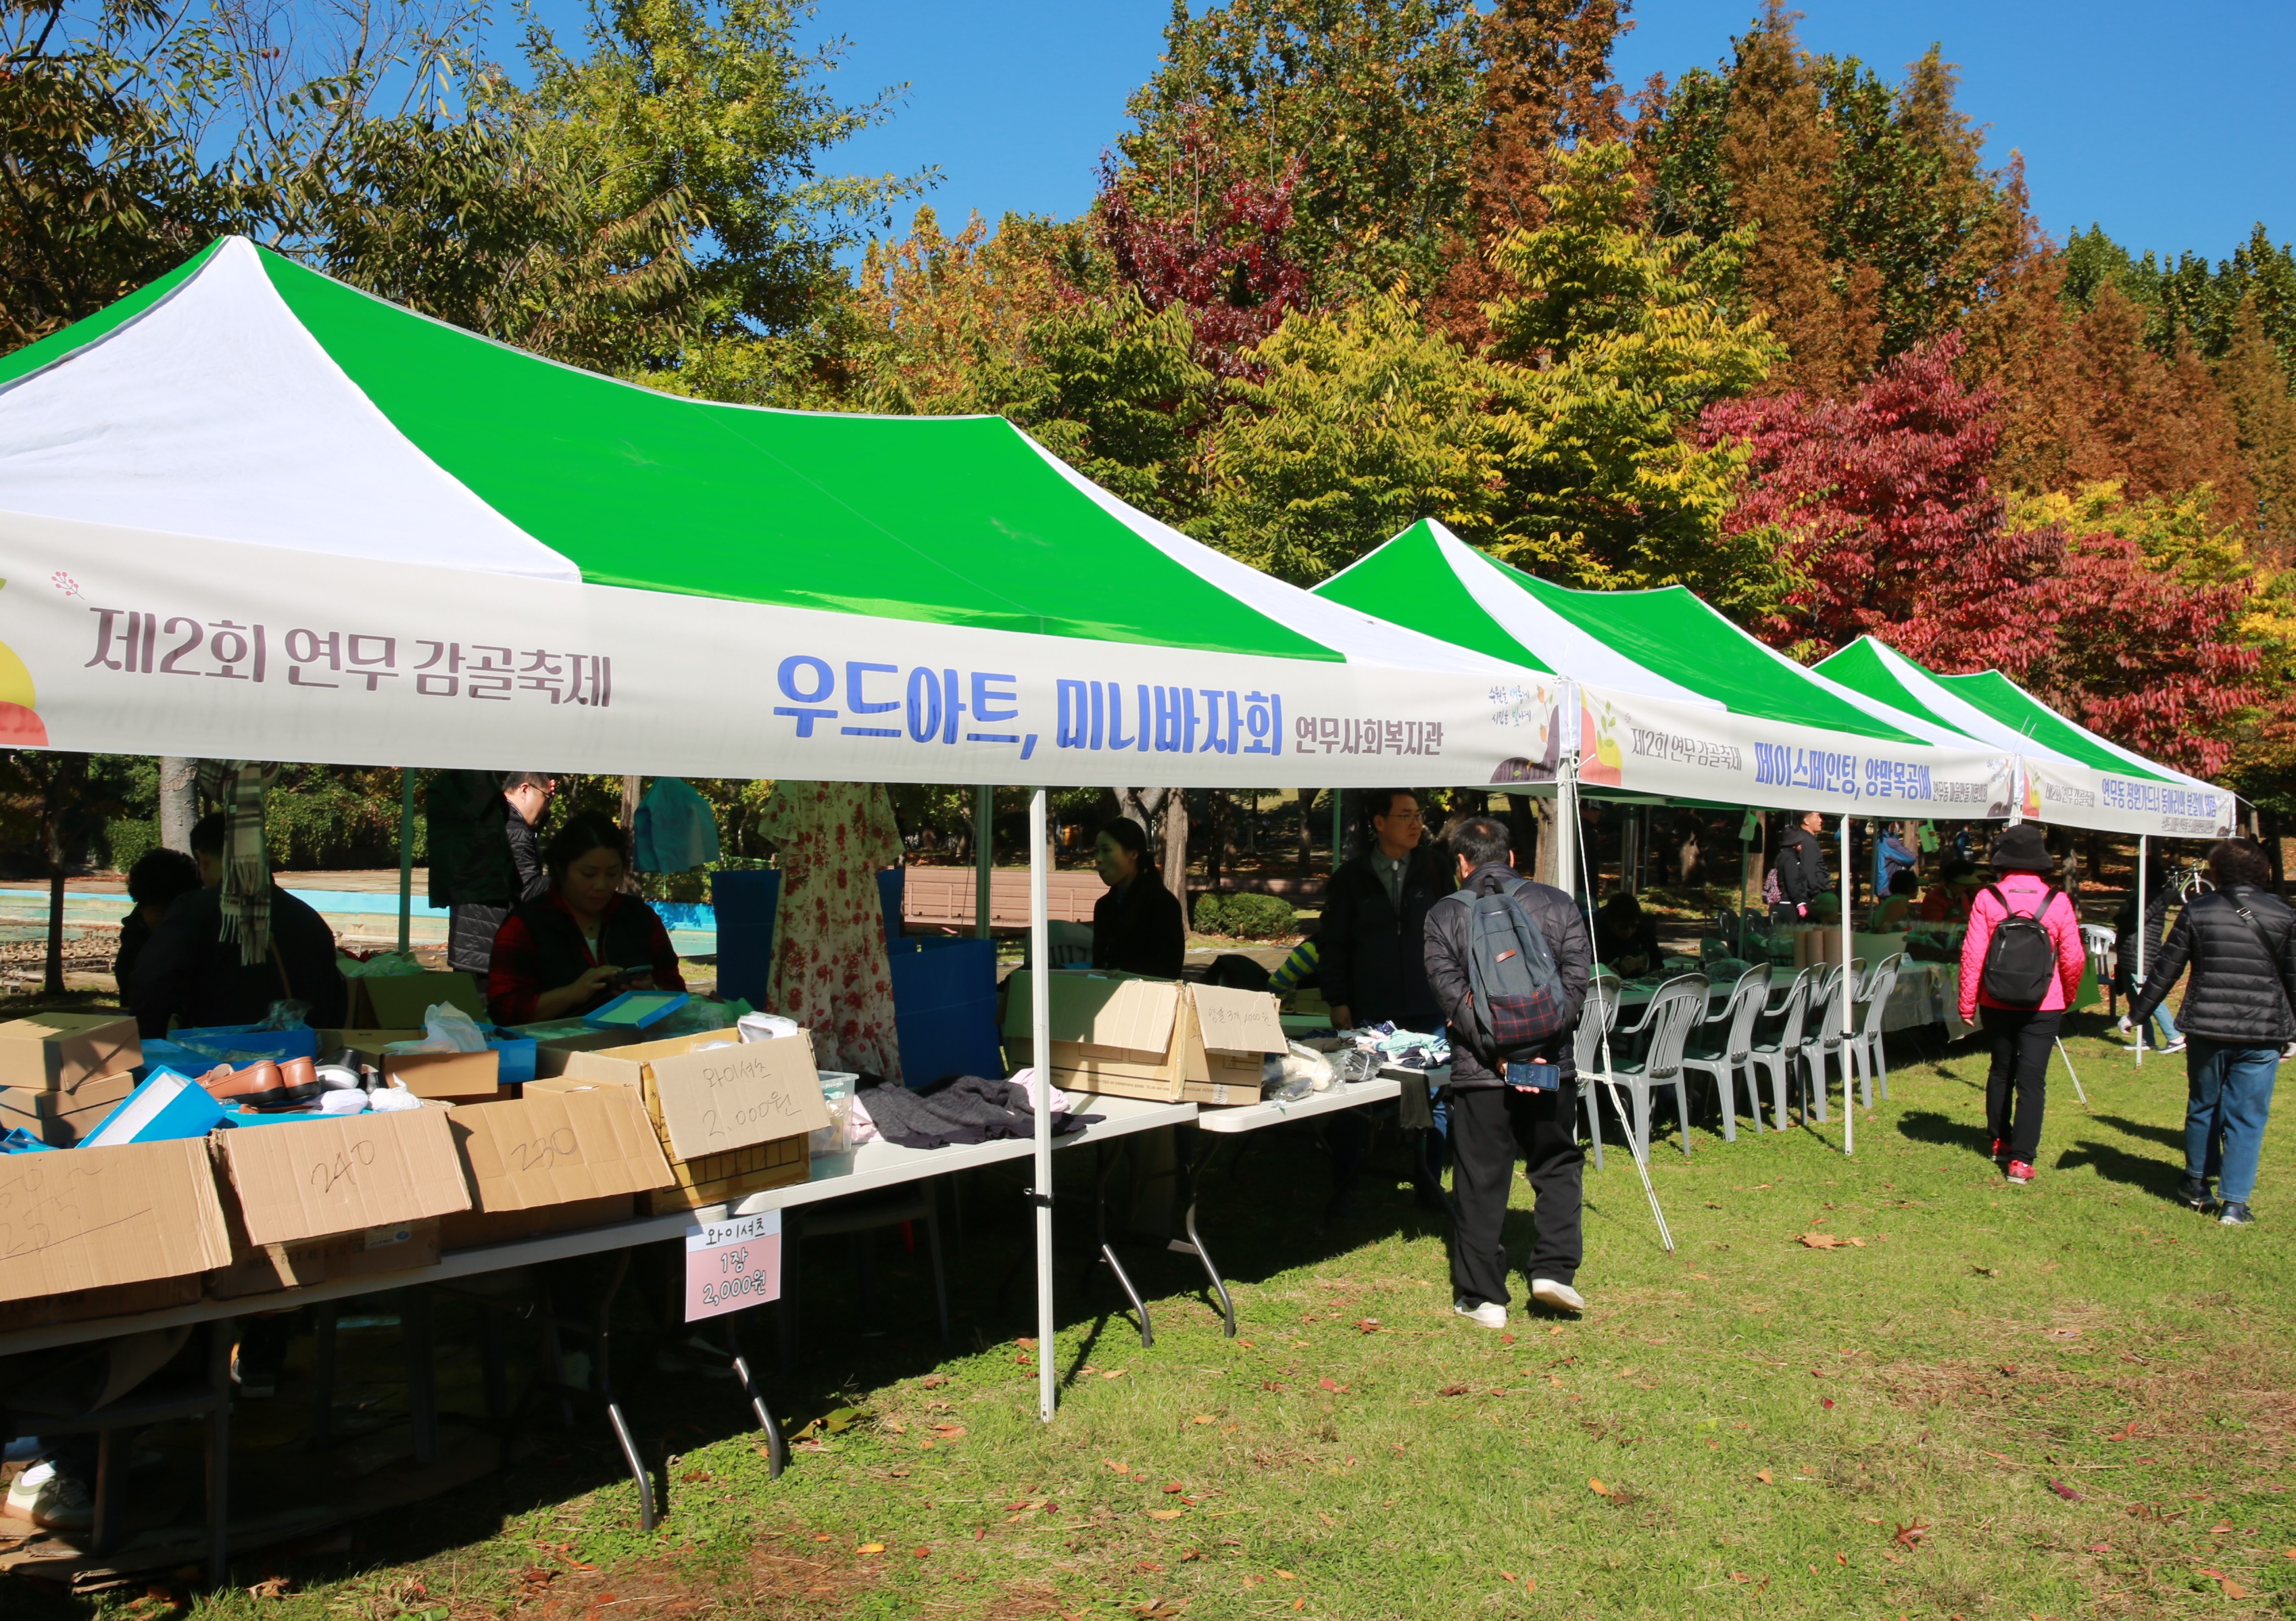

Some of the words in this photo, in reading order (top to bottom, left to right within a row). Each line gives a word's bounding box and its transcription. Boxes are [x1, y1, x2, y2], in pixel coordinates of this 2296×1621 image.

[84, 607, 266, 683] 제2회
[285, 629, 399, 691] 연무
[414, 639, 611, 707] 감골축제
[773, 654, 1038, 760] 우드아트,
[1056, 679, 1282, 756] 미니바자회
[1488, 685, 1508, 704] 수원을
[1295, 715, 1444, 756] 연무사회복지관
[1491, 710, 1509, 725] 시민을
[1630, 728, 1669, 760] 제2회
[1671, 735, 1696, 763] 연무
[1696, 740, 1742, 771] 감골축제
[1754, 742, 1861, 801] 페이스페인팅,
[1865, 757, 1932, 800] 양말목공예
[2102, 777, 2125, 808] 연무동
[2126, 782, 2160, 813] 정원가드너
[702, 1057, 772, 1088] 와이셔츠
[311, 1140, 375, 1194] 240
[510, 1128, 579, 1171] 230
[706, 1217, 766, 1246] 와이셔츠
[721, 1247, 749, 1274] 1장
[703, 1269, 766, 1307] 2,000원
